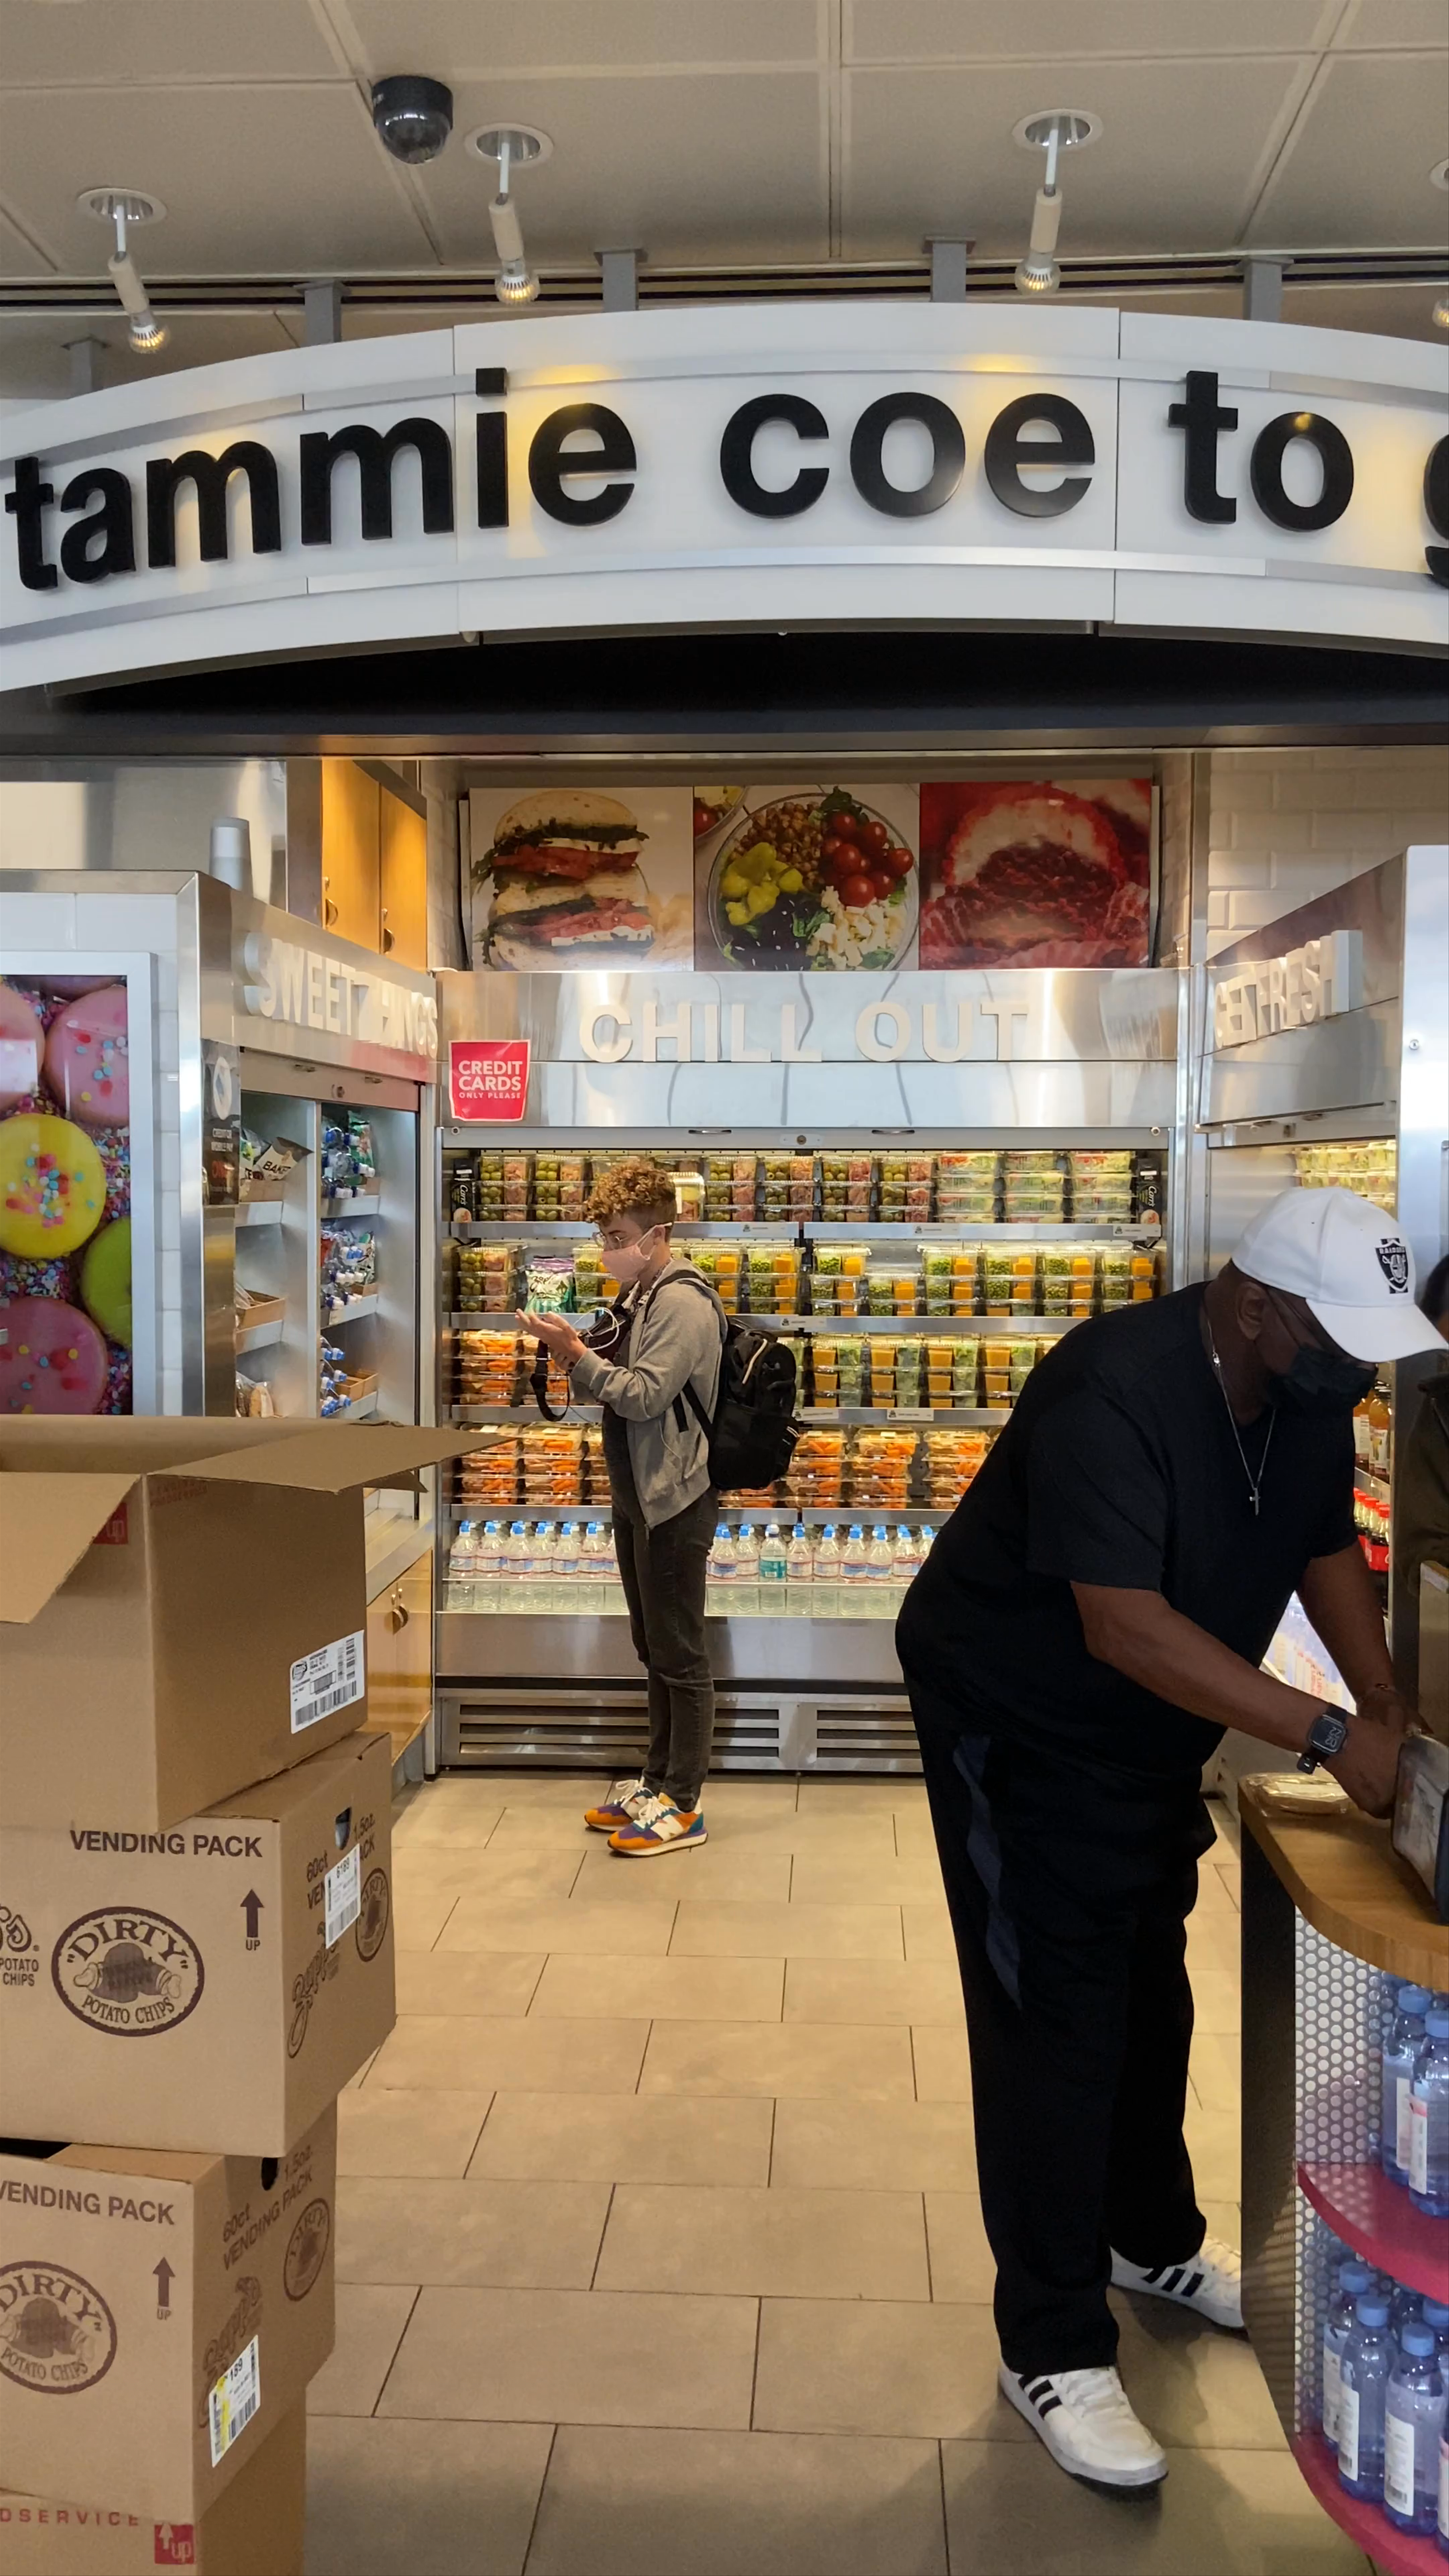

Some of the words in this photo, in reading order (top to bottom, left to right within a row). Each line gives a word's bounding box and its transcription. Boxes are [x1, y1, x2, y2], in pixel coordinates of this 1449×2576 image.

[5, 368, 638, 591] tammie
[720, 392, 1097, 518] coe
[1169, 371, 1355, 532] to
[245, 932, 356, 1036] SWEET
[1256, 929, 1363, 1036] FRESH
[579, 1001, 822, 1063] CHILL
[855, 1001, 1029, 1063] OUT
[458, 1060, 523, 1075] CREDIT
[458, 1076, 521, 1091] CARDS
[69, 1830, 185, 1855] VENDING
[193, 1834, 263, 1858] PACK
[246, 1940, 260, 1950] UP
[3, 1972, 35, 1987] CHIPS
[82, 1995, 130, 2024] POTATO
[135, 1996, 175, 2024] CHIPS
[108, 2196, 175, 2225] PACK
[223, 2201, 280, 2271] VENDING
[283, 2165, 312, 2212] PACK
[157, 2308, 172, 2320] UP
[1, 2347, 46, 2380] POTATO
[51, 2361, 88, 2381] CHIPS
